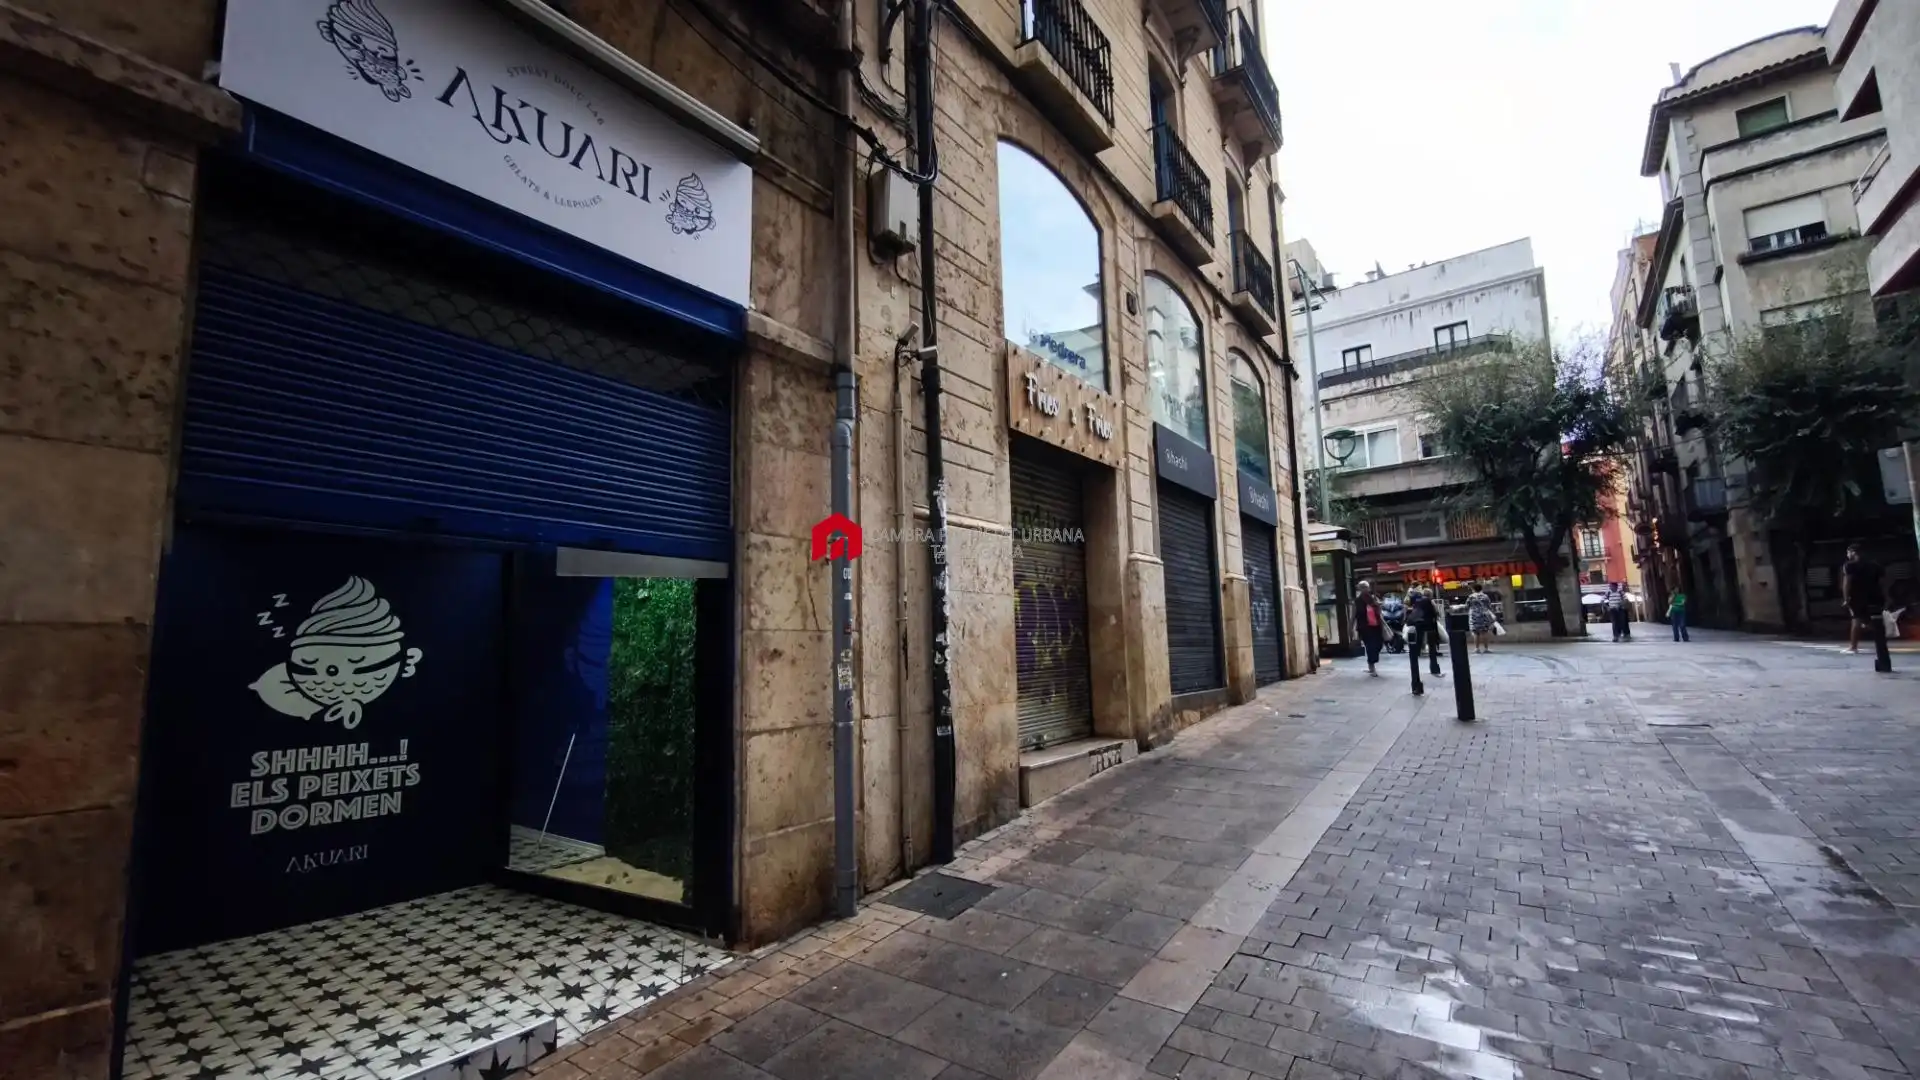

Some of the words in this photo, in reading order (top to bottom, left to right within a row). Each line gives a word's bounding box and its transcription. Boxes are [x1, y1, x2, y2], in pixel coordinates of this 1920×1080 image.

[435, 66, 652, 203] AKUARI
[503, 154, 541, 193] GELATS
[1404, 566, 1471, 583] KEAB
[1476, 561, 1538, 578] HOUS
[230, 778, 289, 808] ELS
[299, 763, 421, 800] PEIXETS
[250, 791, 402, 835] DORMEN
[285, 844, 369, 874] AKUARI
